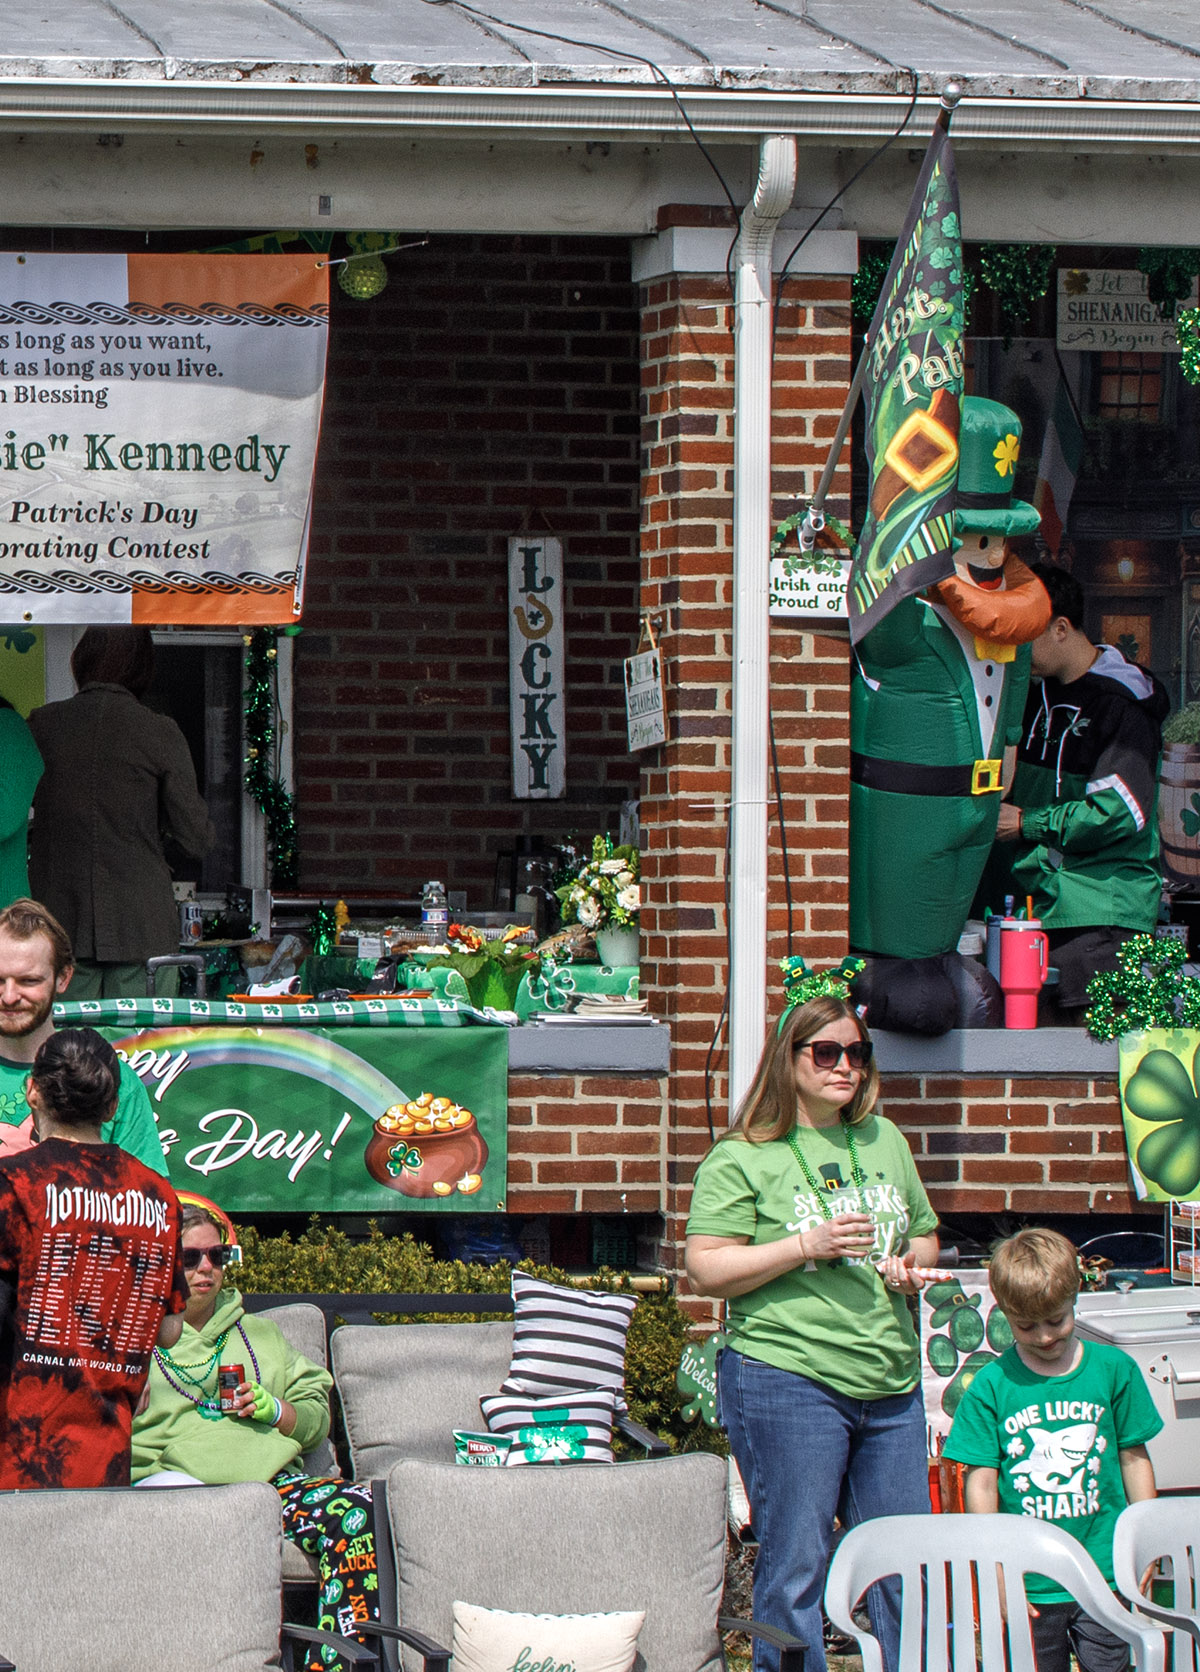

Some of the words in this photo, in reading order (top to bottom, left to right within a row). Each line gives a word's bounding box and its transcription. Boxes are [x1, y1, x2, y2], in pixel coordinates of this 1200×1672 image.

[15, 331, 65, 355] long
[71, 336, 95, 349] as
[100, 336, 142, 354] you
[147, 333, 211, 353] want,
[1101, 327, 1154, 351] Begin
[14, 362, 38, 376] as
[44, 358, 95, 381] long
[100, 363, 124, 376] as
[129, 363, 171, 381] you
[177, 358, 224, 377] live.
[14, 384, 109, 410] Blessing
[83, 433, 291, 482] Kennedy
[9, 501, 133, 523] Patrick's
[141, 502, 198, 529] Day
[108, 536, 211, 559] Contest
[774, 577, 810, 592] Irish
[769, 593, 818, 609] Proud
[826, 596, 842, 612] of
[184, 1108, 352, 1182] Day!
[23, 1353, 64, 1367] CARNAL
[89, 1358, 122, 1373] WORLD
[1004, 1404, 1043, 1435] ONE
[1045, 1400, 1106, 1423] LUCKY
[1021, 1489, 1100, 1520] SHARK
[344, 1532, 374, 1559] GET
